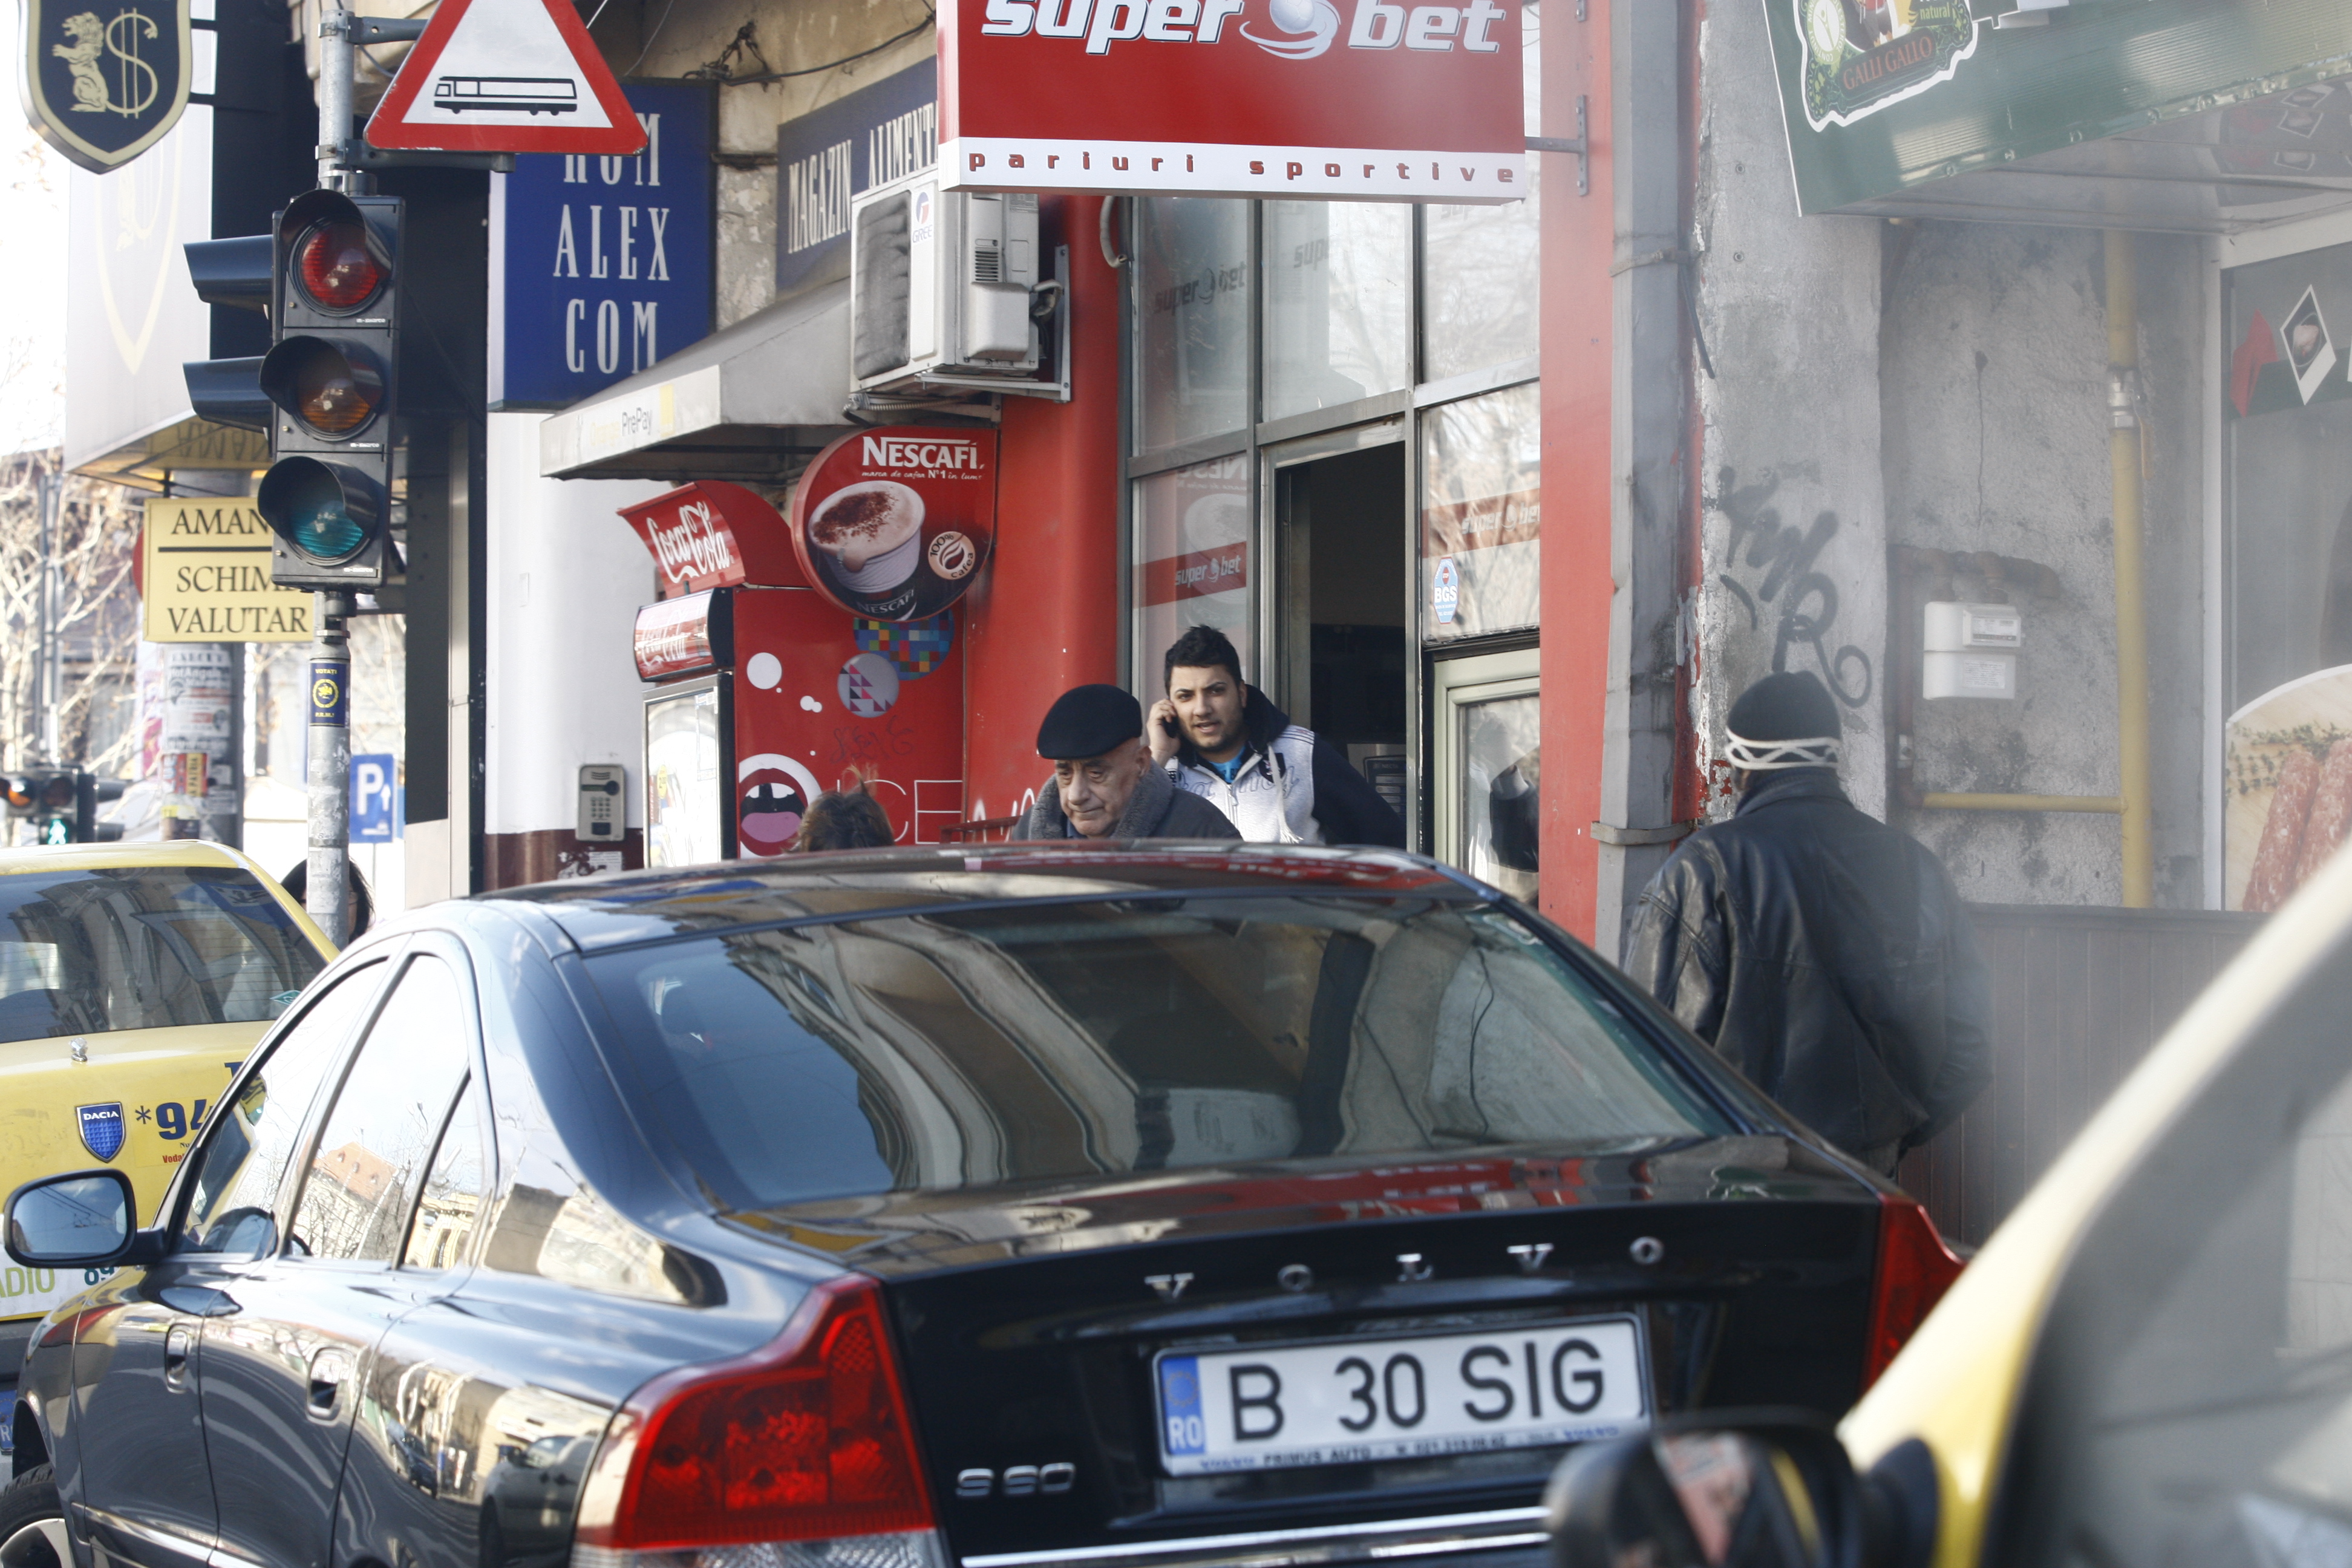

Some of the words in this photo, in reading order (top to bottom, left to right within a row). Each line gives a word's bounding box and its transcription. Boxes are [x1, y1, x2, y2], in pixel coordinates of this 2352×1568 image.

[1919, 2, 1950, 20] natural
[981, 0, 1243, 56] super
[1348, 0, 1506, 53] bet
[1843, 54, 1883, 90] GALLI
[1885, 36, 1933, 73] GALLO
[788, 139, 852, 253] MAGAZIN
[869, 100, 938, 189] ALIMENT
[969, 151, 1195, 173] pariuri
[1249, 160, 1513, 182] sportive
[553, 204, 670, 281] ALEX
[912, 224, 933, 243] GREE
[566, 298, 658, 374] COM
[622, 407, 652, 437] PrePay
[171, 508, 269, 535] AMAN
[930, 534, 954, 557] 100%
[177, 566, 299, 593] SCHIM
[1174, 564, 1208, 589] super
[1220, 554, 1242, 577] bet
[1434, 585, 1457, 603] BGS
[167, 606, 309, 633] VALUTAR
[356, 763, 384, 815] P
[83, 1110, 119, 1120] DACIA
[162, 1153, 184, 1164] Voda
[1145, 1236, 1664, 1301] VOLVO
[1229, 1364, 1284, 1442] B
[1334, 1352, 1426, 1432] 30
[1461, 1338, 1604, 1422] SIG
[1168, 1414, 1204, 1448] RO
